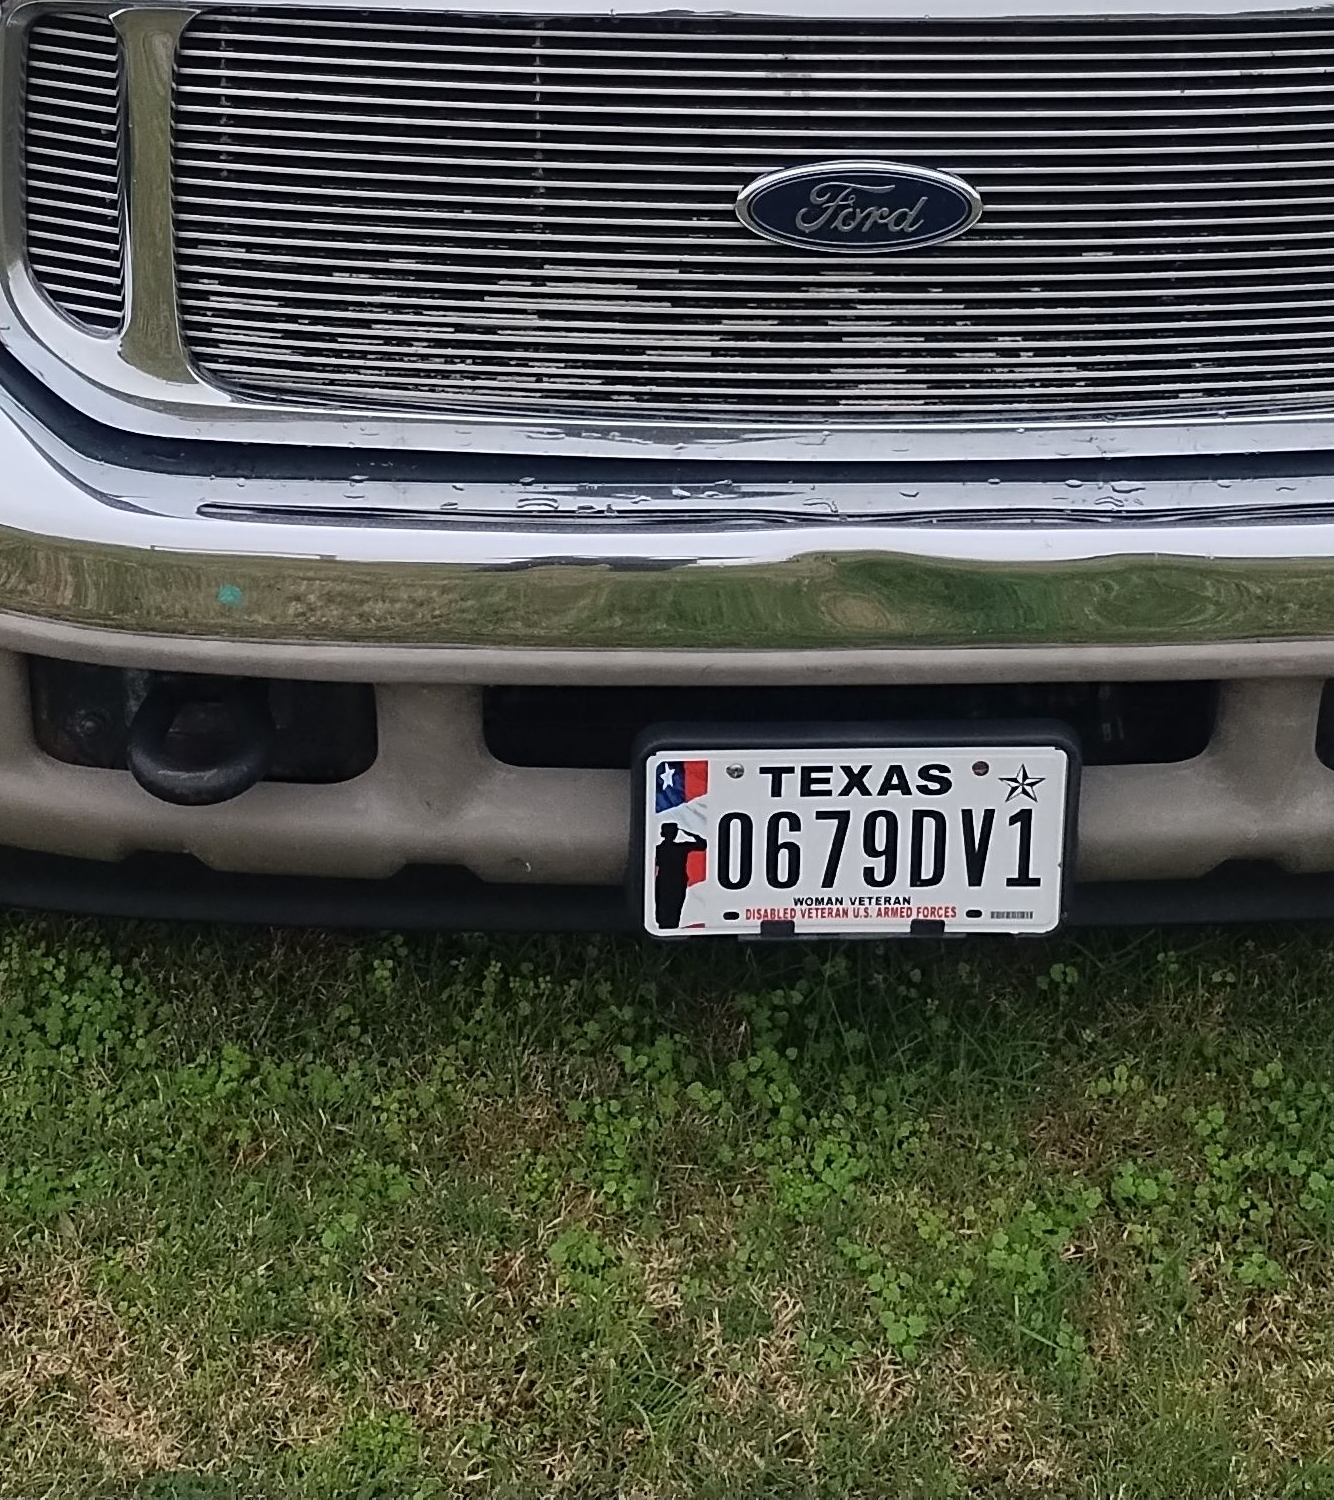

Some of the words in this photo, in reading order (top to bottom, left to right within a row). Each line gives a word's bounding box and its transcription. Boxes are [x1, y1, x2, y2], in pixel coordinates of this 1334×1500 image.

[795, 181, 929, 234] Ford
[759, 763, 953, 798] TEXAS
[716, 807, 1042, 891] 0679DV1
[745, 908, 797, 921] DISABLED
[800, 907, 849, 919] VETERAN
[852, 907, 873, 919] U.S.
[876, 906, 913, 919] ARMED
[916, 906, 958, 919] FORCES
[793, 897, 845, 907] WOMAN
[849, 896, 912, 906] VETERAN
